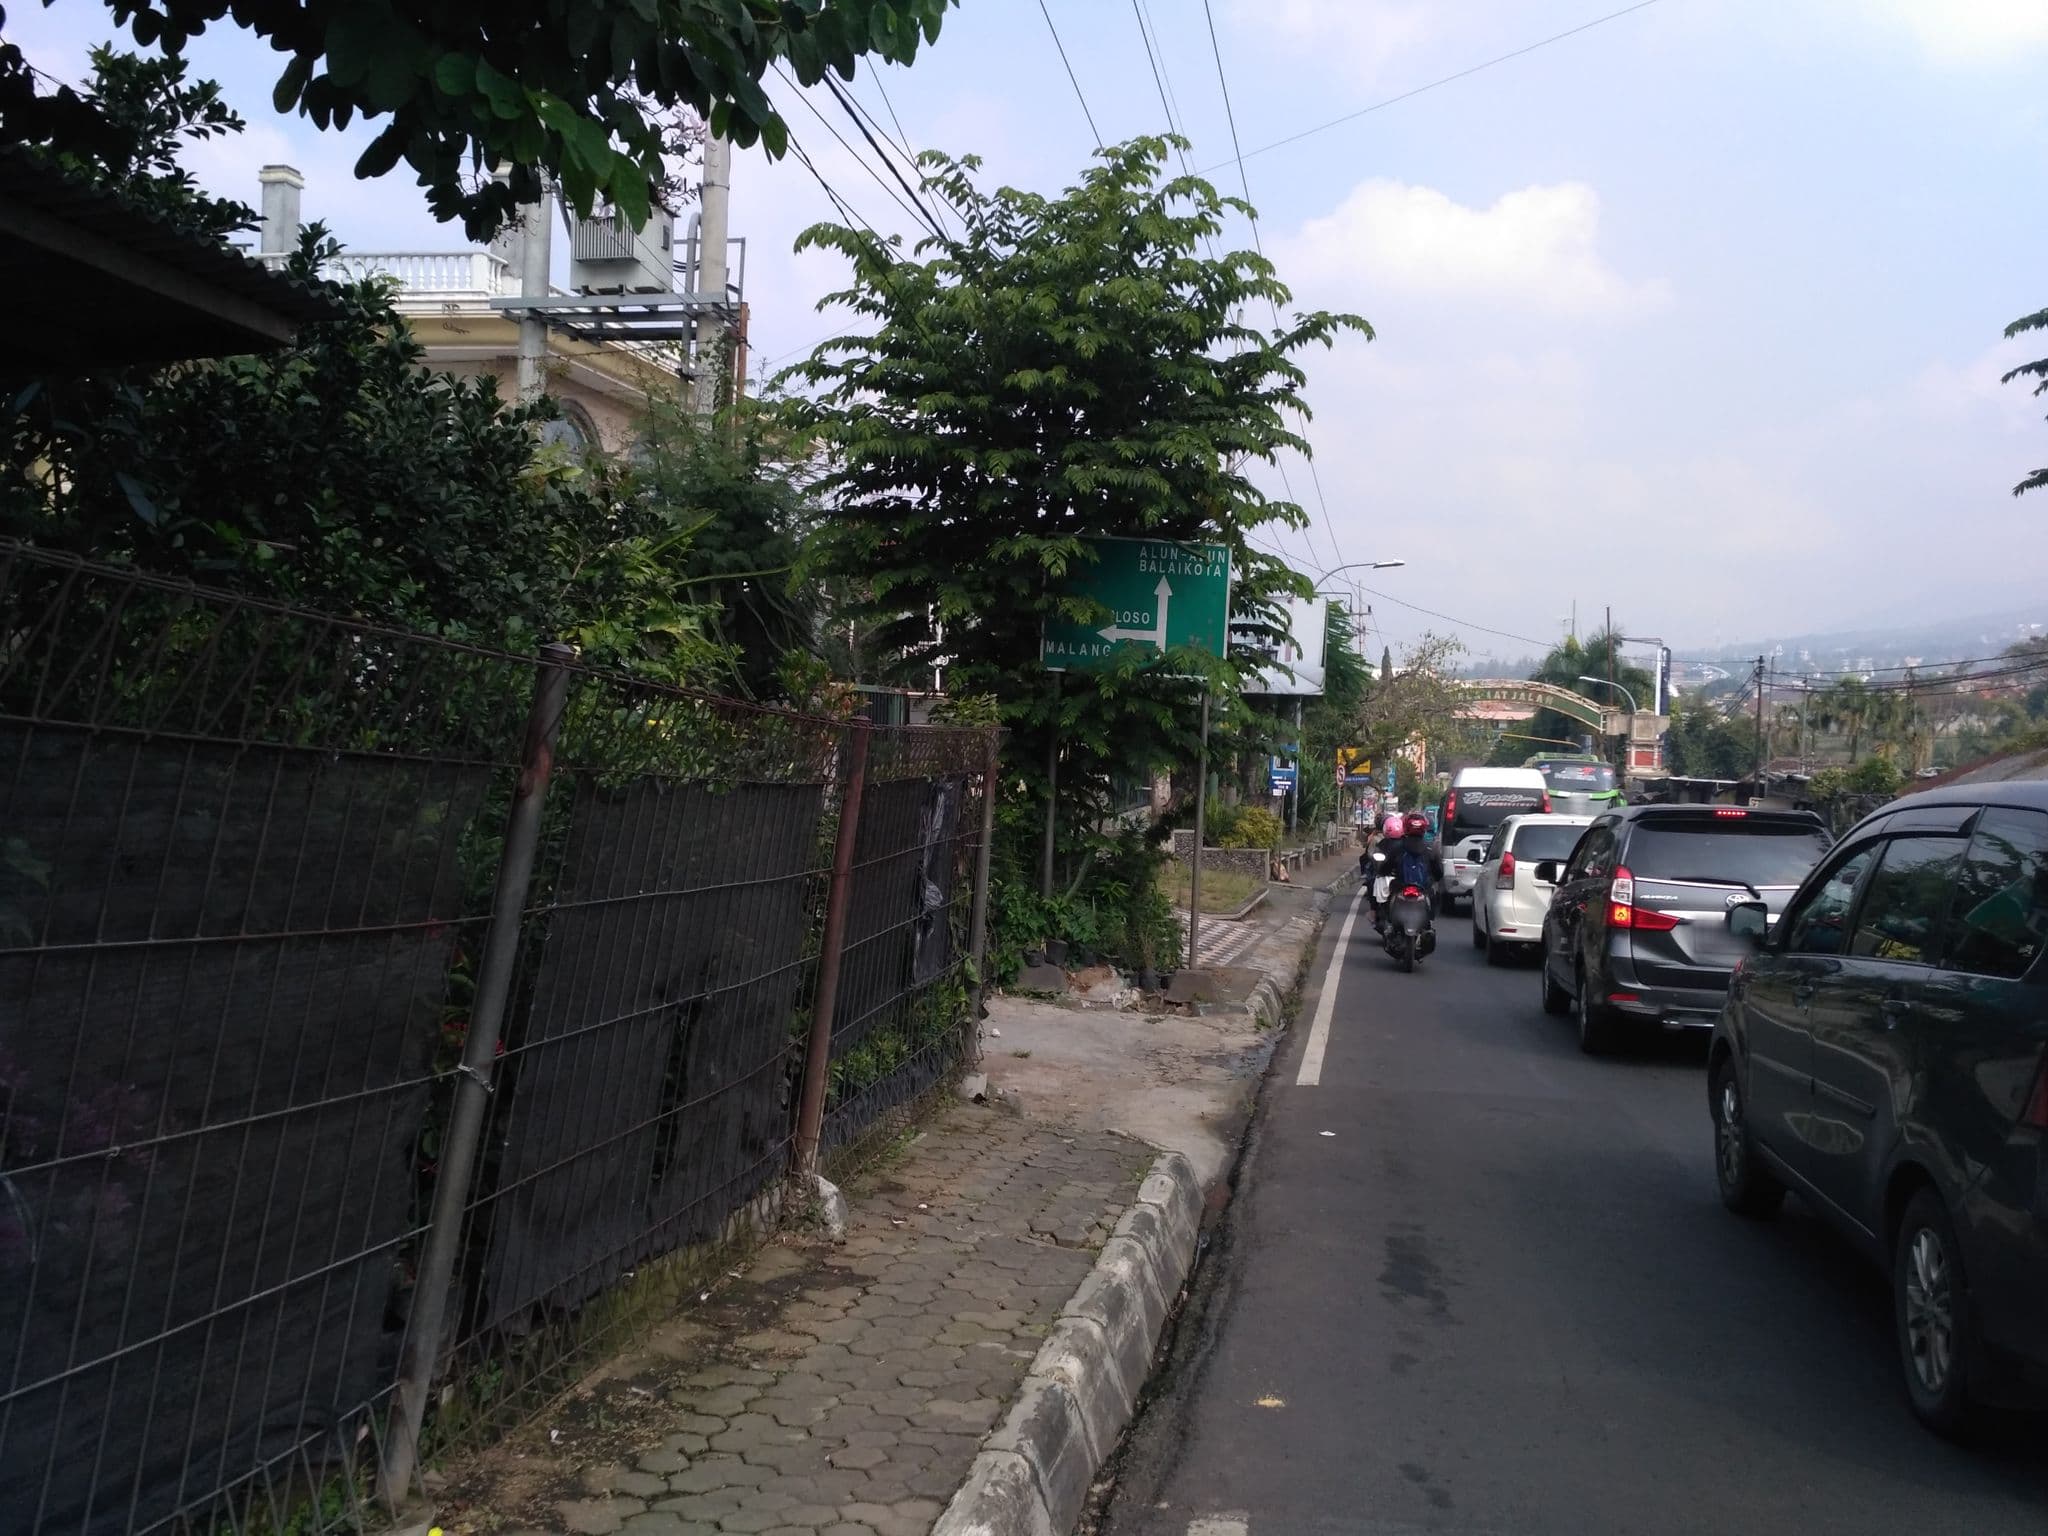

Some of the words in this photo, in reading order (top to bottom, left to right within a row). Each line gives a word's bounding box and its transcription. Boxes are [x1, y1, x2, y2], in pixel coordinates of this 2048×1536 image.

[1139, 546, 1226, 563] ALUN-AUN
[1139, 559, 1222, 577] BALAIKOTA
[1111, 609, 1150, 624] LOSO
[1046, 640, 1111, 657] MALANG
[1511, 691, 1554, 705] JALAN
